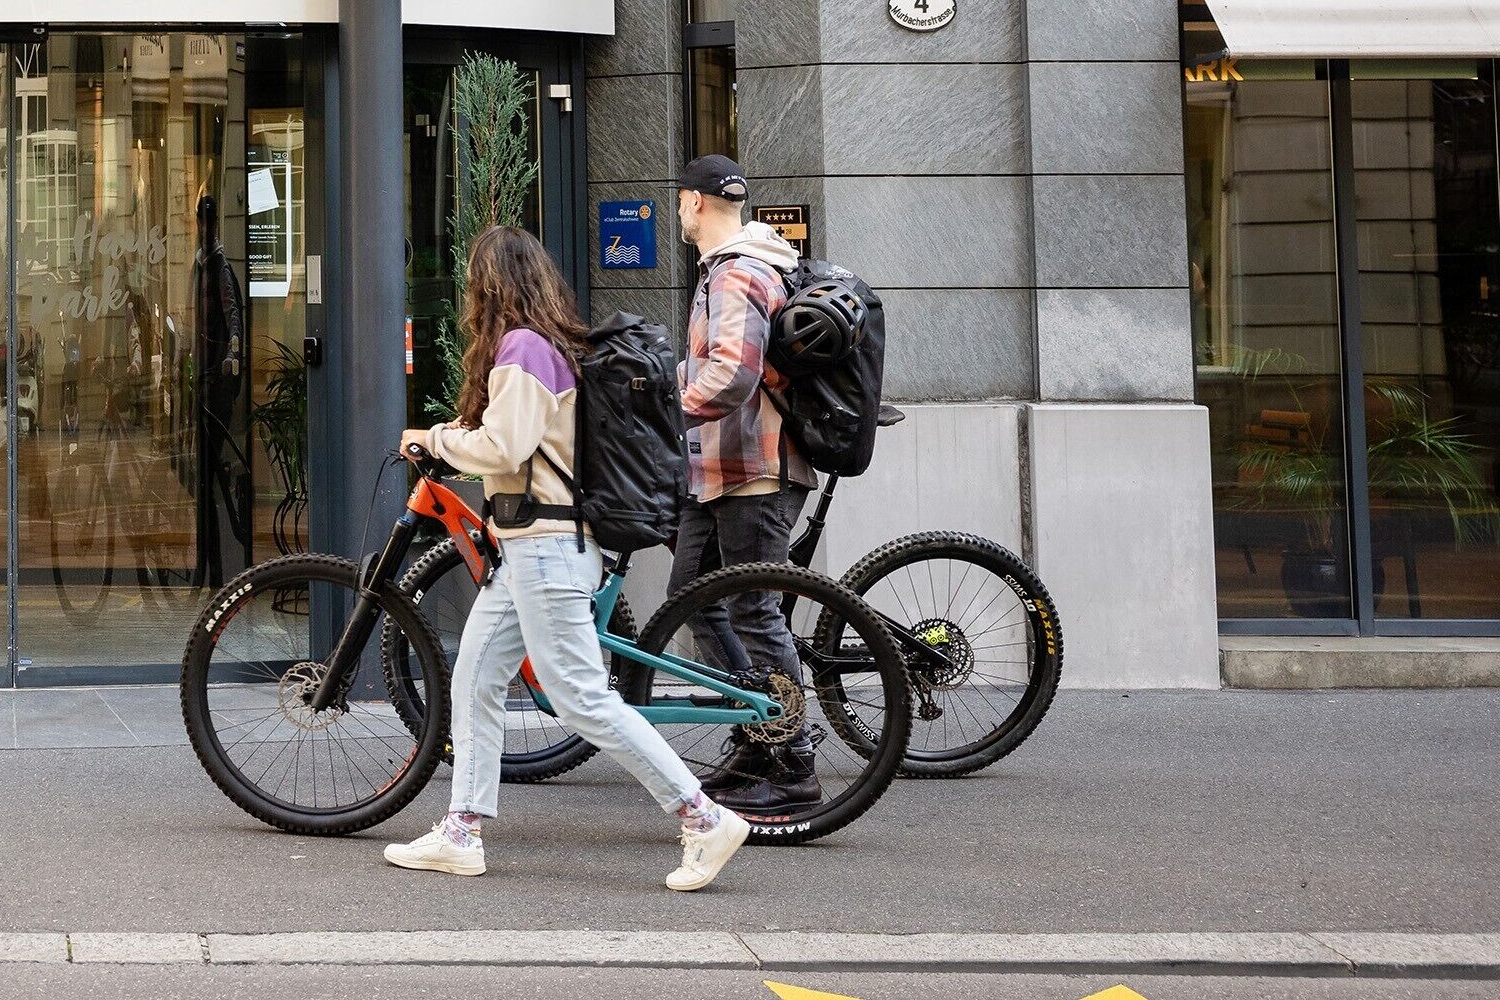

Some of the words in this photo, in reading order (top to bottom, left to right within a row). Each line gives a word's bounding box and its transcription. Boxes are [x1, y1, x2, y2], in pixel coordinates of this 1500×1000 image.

[619, 208, 639, 217] Rotary
[1003, 574, 1028, 597] SWISS
[205, 582, 253, 633] MAXXIS
[1022, 598, 1037, 612] DT
[1034, 599, 1056, 656] MAXXIS
[842, 702, 856, 716] DT
[852, 717, 876, 741] SWISS
[752, 821, 811, 835] MAXXI
